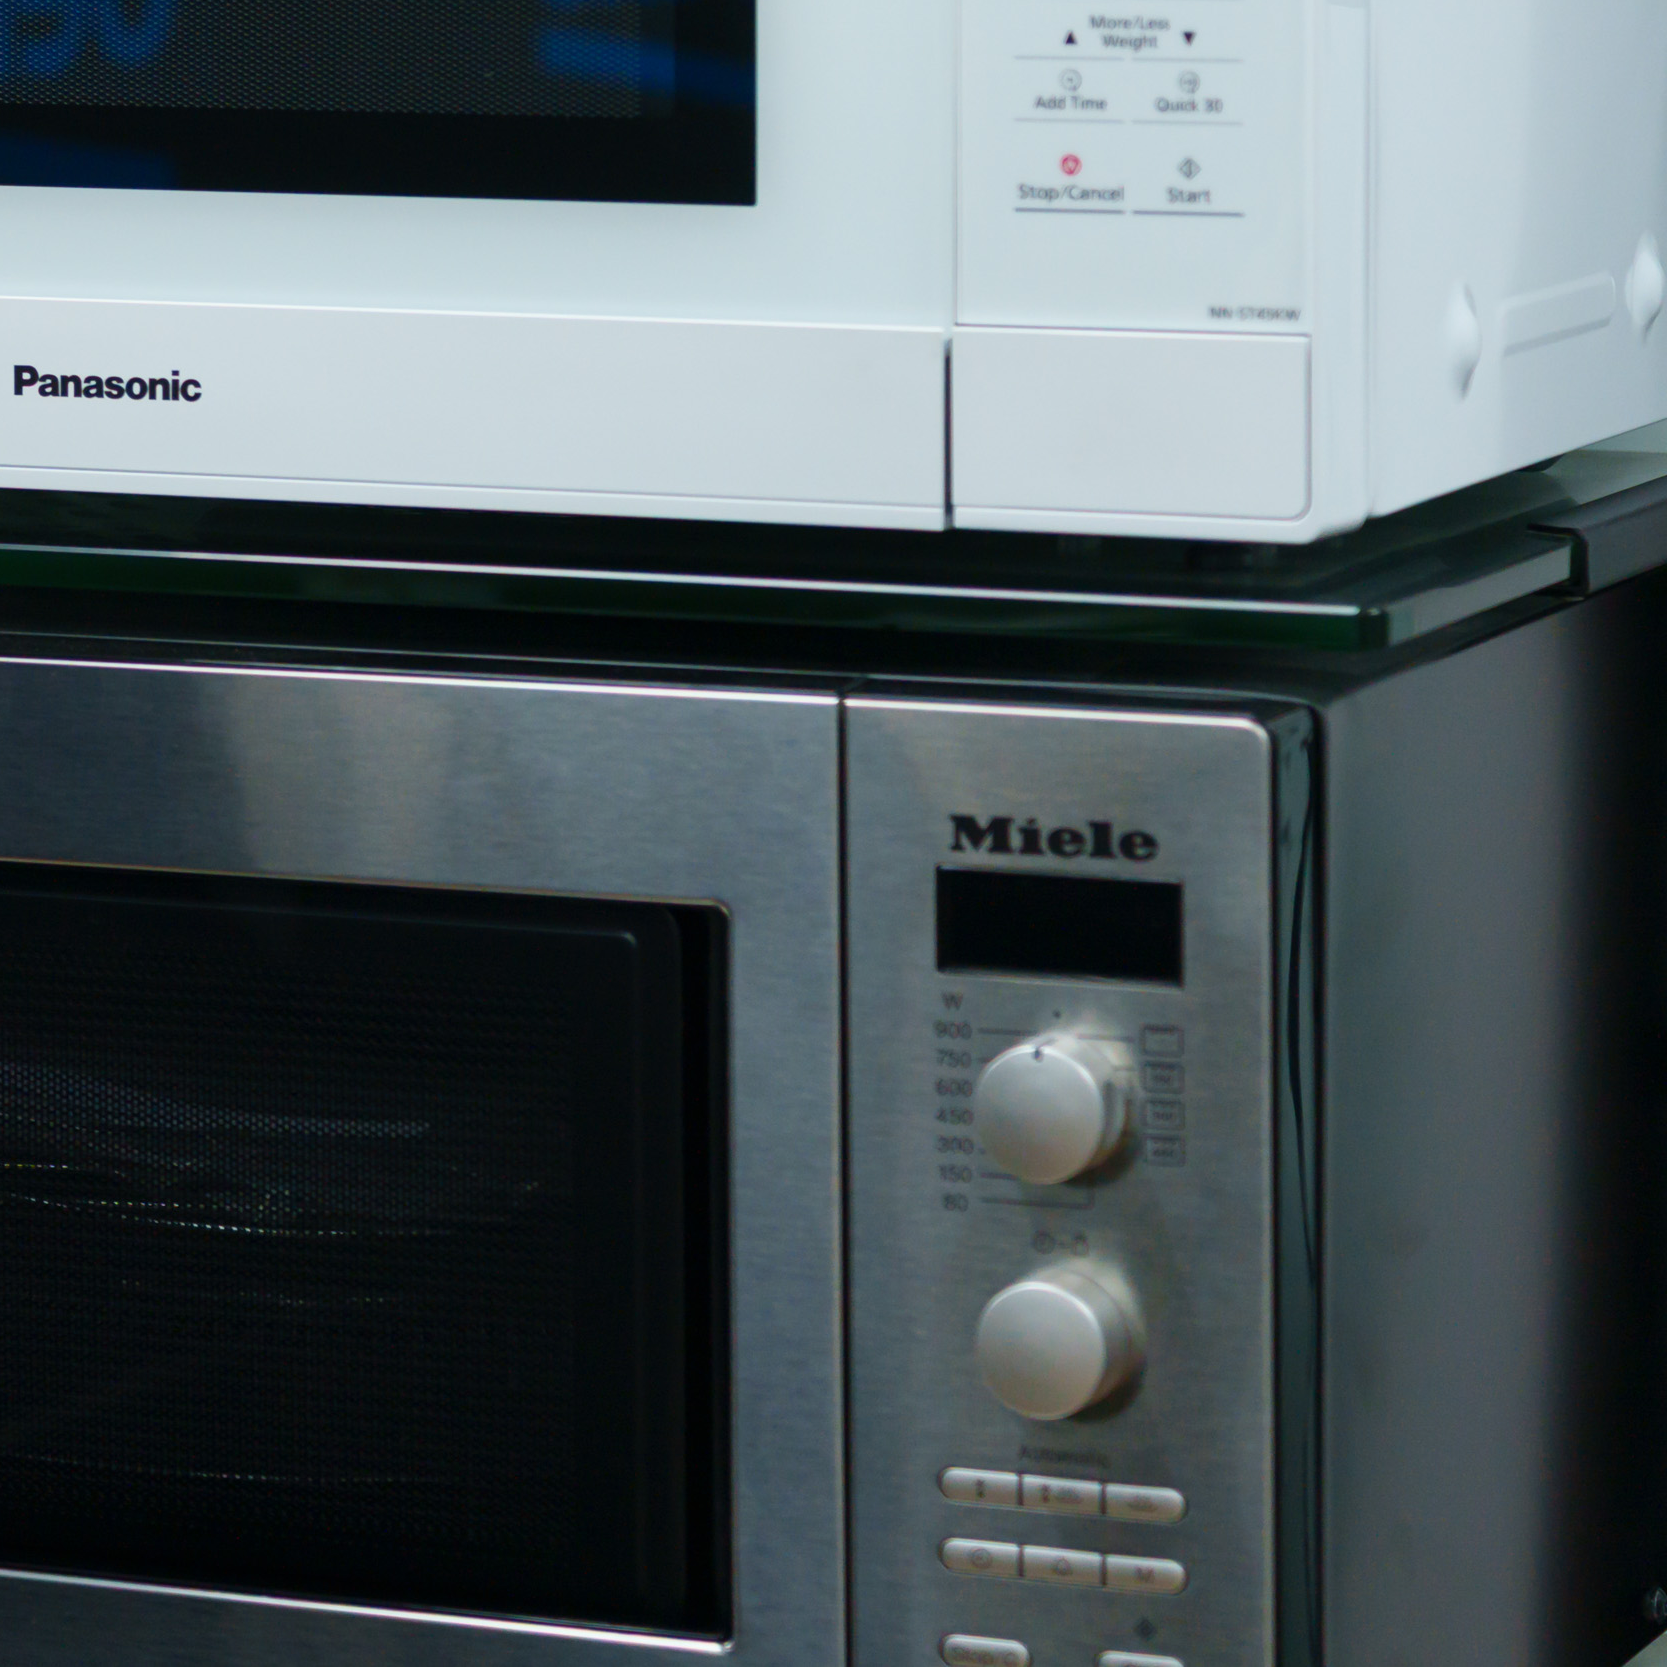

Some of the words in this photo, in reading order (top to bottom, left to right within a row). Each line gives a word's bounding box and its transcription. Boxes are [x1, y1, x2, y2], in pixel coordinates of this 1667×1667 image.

[1089, 15, 1170, 30] More/Less
[1103, 34, 1158, 51] Weight
[1035, 96, 1066, 111] Add
[1072, 96, 1107, 111] Time
[1155, 98, 1198, 113] Quick
[1018, 184, 1124, 202] Stop/Cancel
[1166, 187, 1211, 203] Start
[13, 364, 202, 402] Panasonic
[949, 814, 1159, 861] Miele
[933, 1021, 972, 1040] 900
[936, 1049, 971, 1069] 750
[934, 1078, 972, 1098] 600
[935, 1107, 973, 1126] 450
[937, 1136, 973, 1155] 300
[939, 1165, 972, 1183] 150
[943, 1193, 969, 1212] 80
